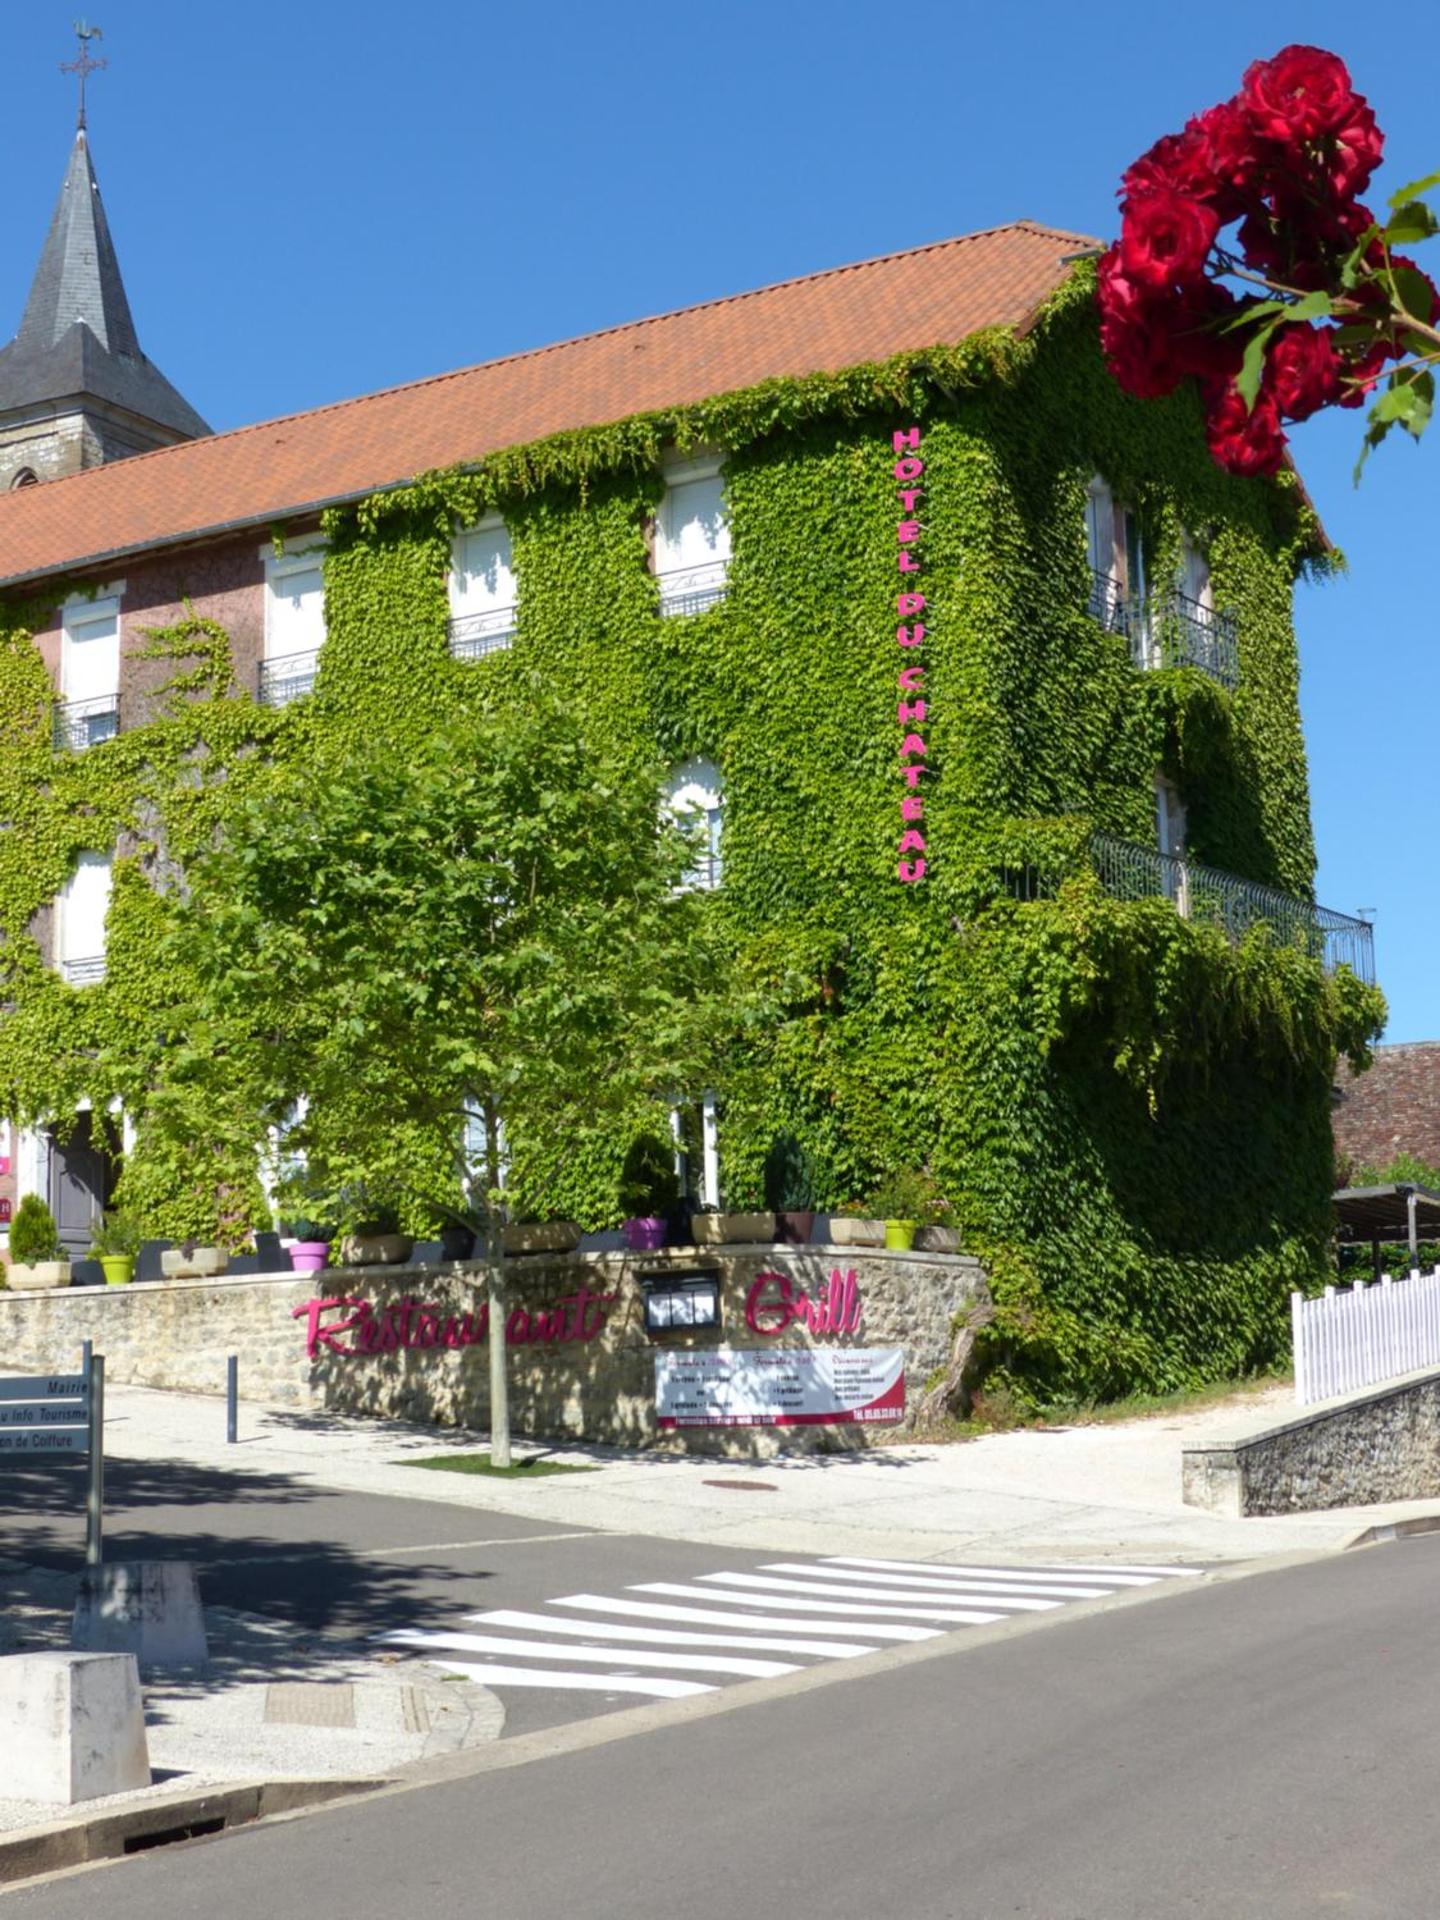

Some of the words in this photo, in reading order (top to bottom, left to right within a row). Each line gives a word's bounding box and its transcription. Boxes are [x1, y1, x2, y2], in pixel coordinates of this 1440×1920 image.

[892, 427, 924, 573] HOTEL
[896, 592, 926, 648] DU
[898, 666, 928, 882] CHATEAU
[745, 1267, 862, 1336] Grill
[12, 1408, 34, 1422] Info
[39, 1407, 88, 1421] Tourisme
[47, 1380, 88, 1394] Mairie
[15, 1434, 29, 1447] de
[32, 1433, 73, 1447] Coiffure
